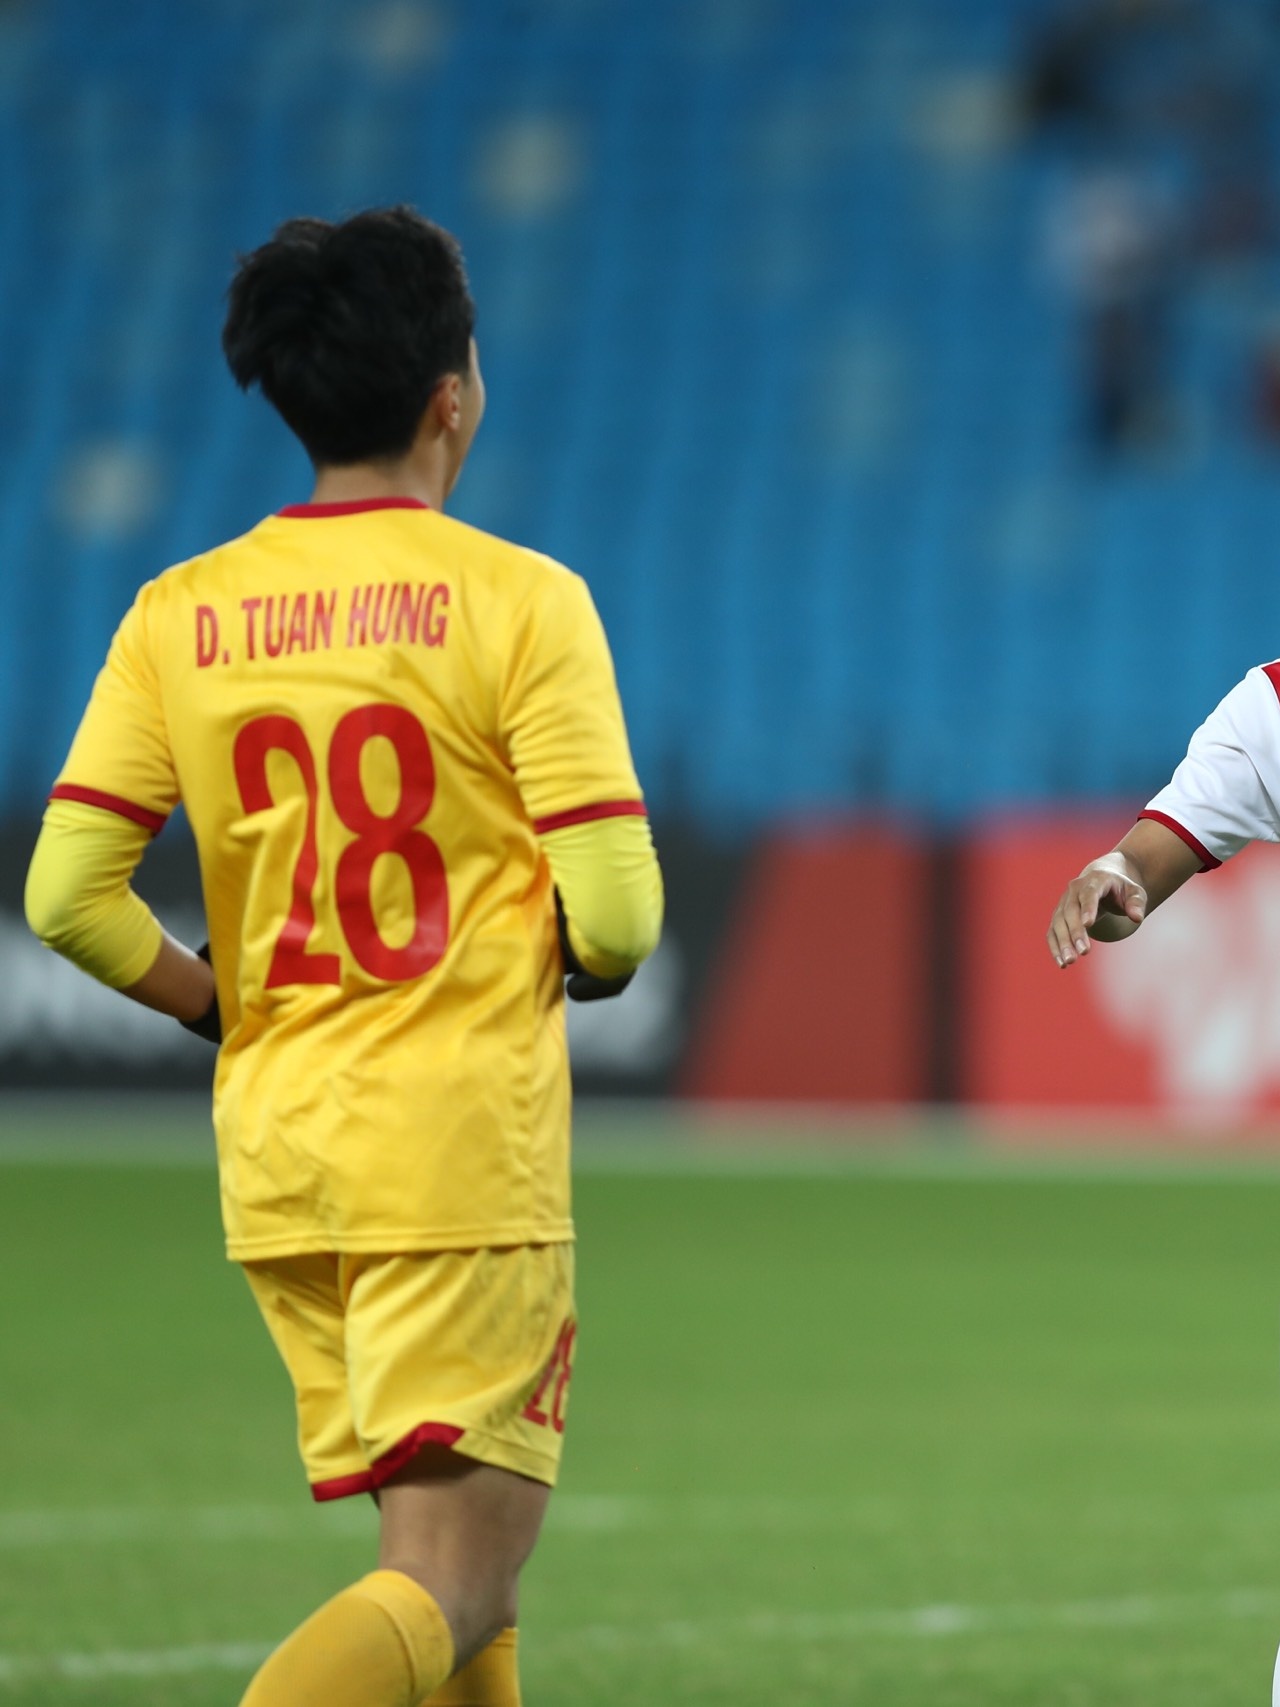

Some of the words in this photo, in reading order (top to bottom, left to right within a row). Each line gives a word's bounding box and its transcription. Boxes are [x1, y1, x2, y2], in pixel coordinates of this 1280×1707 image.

[196, 604, 229, 668] D.
[241, 588, 337, 660] TUAN
[346, 582, 449, 648] HUNG
[232, 703, 450, 991] 28
